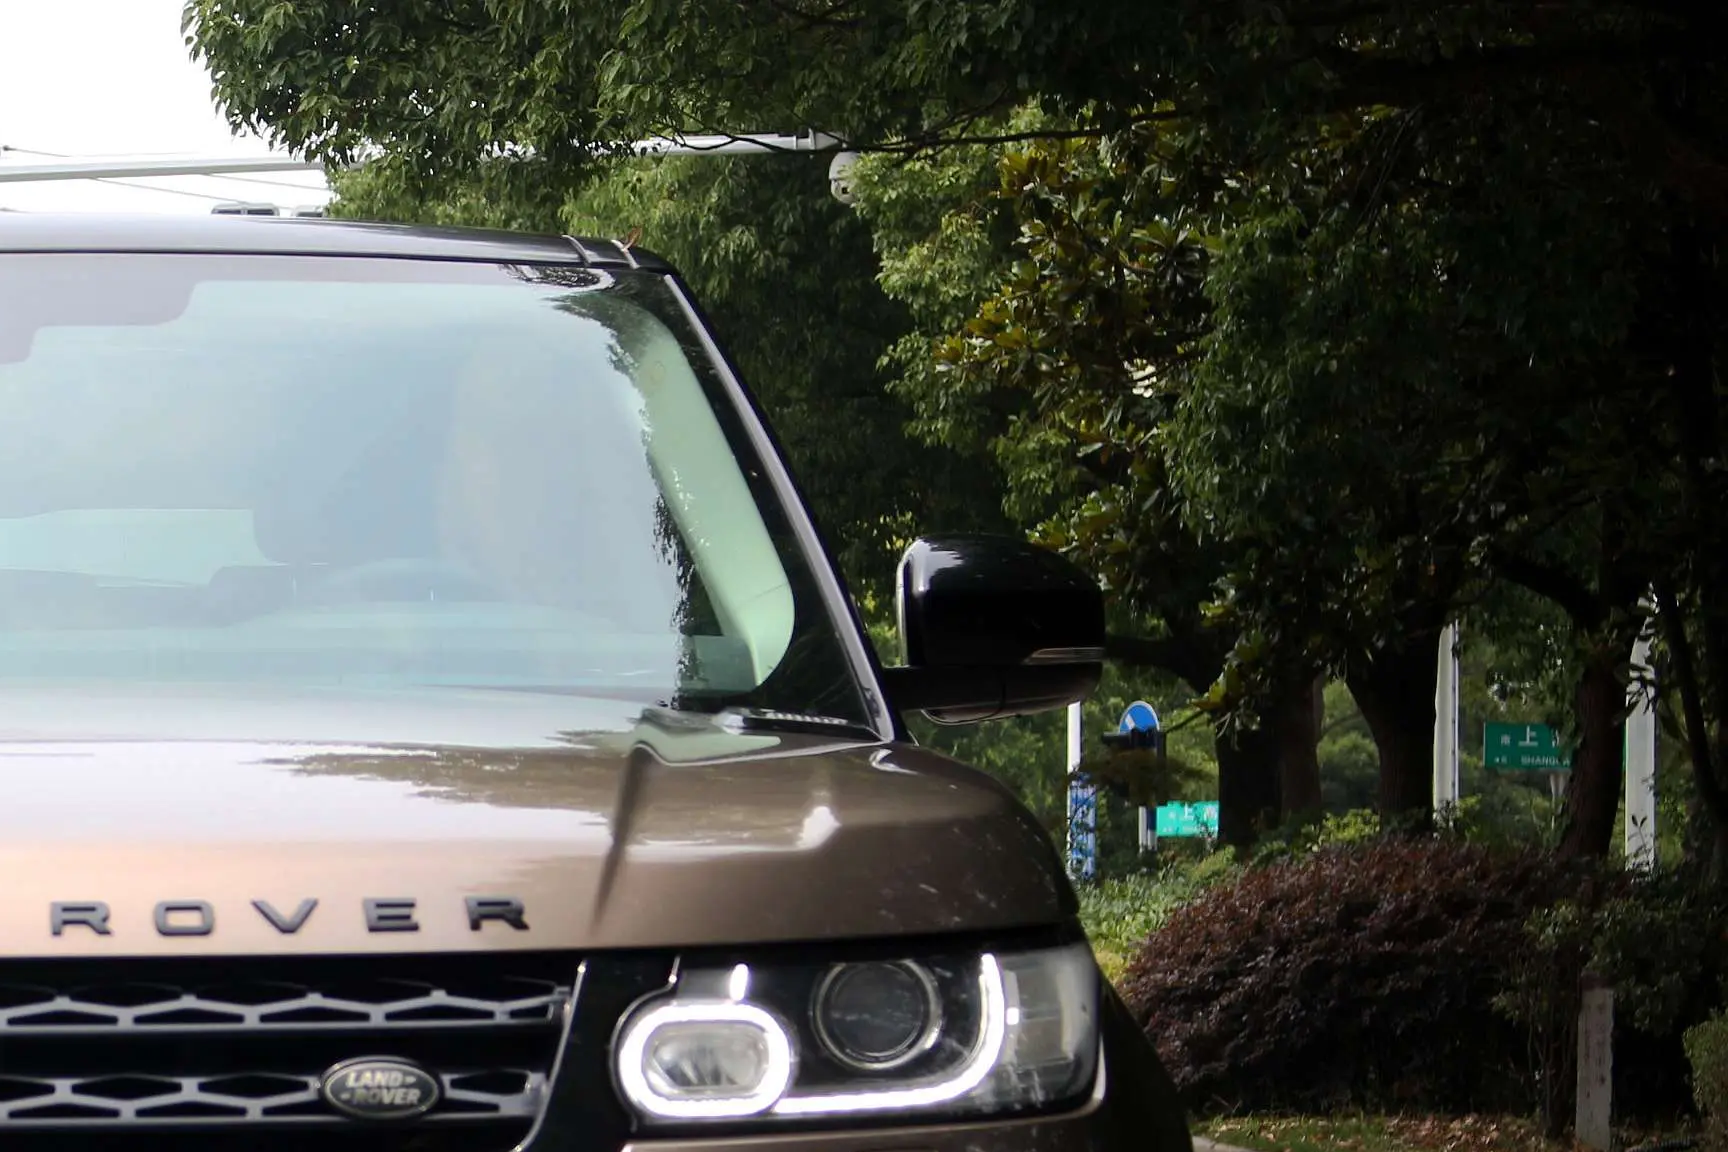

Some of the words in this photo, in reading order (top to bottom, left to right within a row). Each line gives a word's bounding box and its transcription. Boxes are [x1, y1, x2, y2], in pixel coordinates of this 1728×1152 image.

[49, 896, 531, 937] ROVER
[345, 1070, 404, 1088] LAND
[353, 1088, 421, 1105] ROVER
